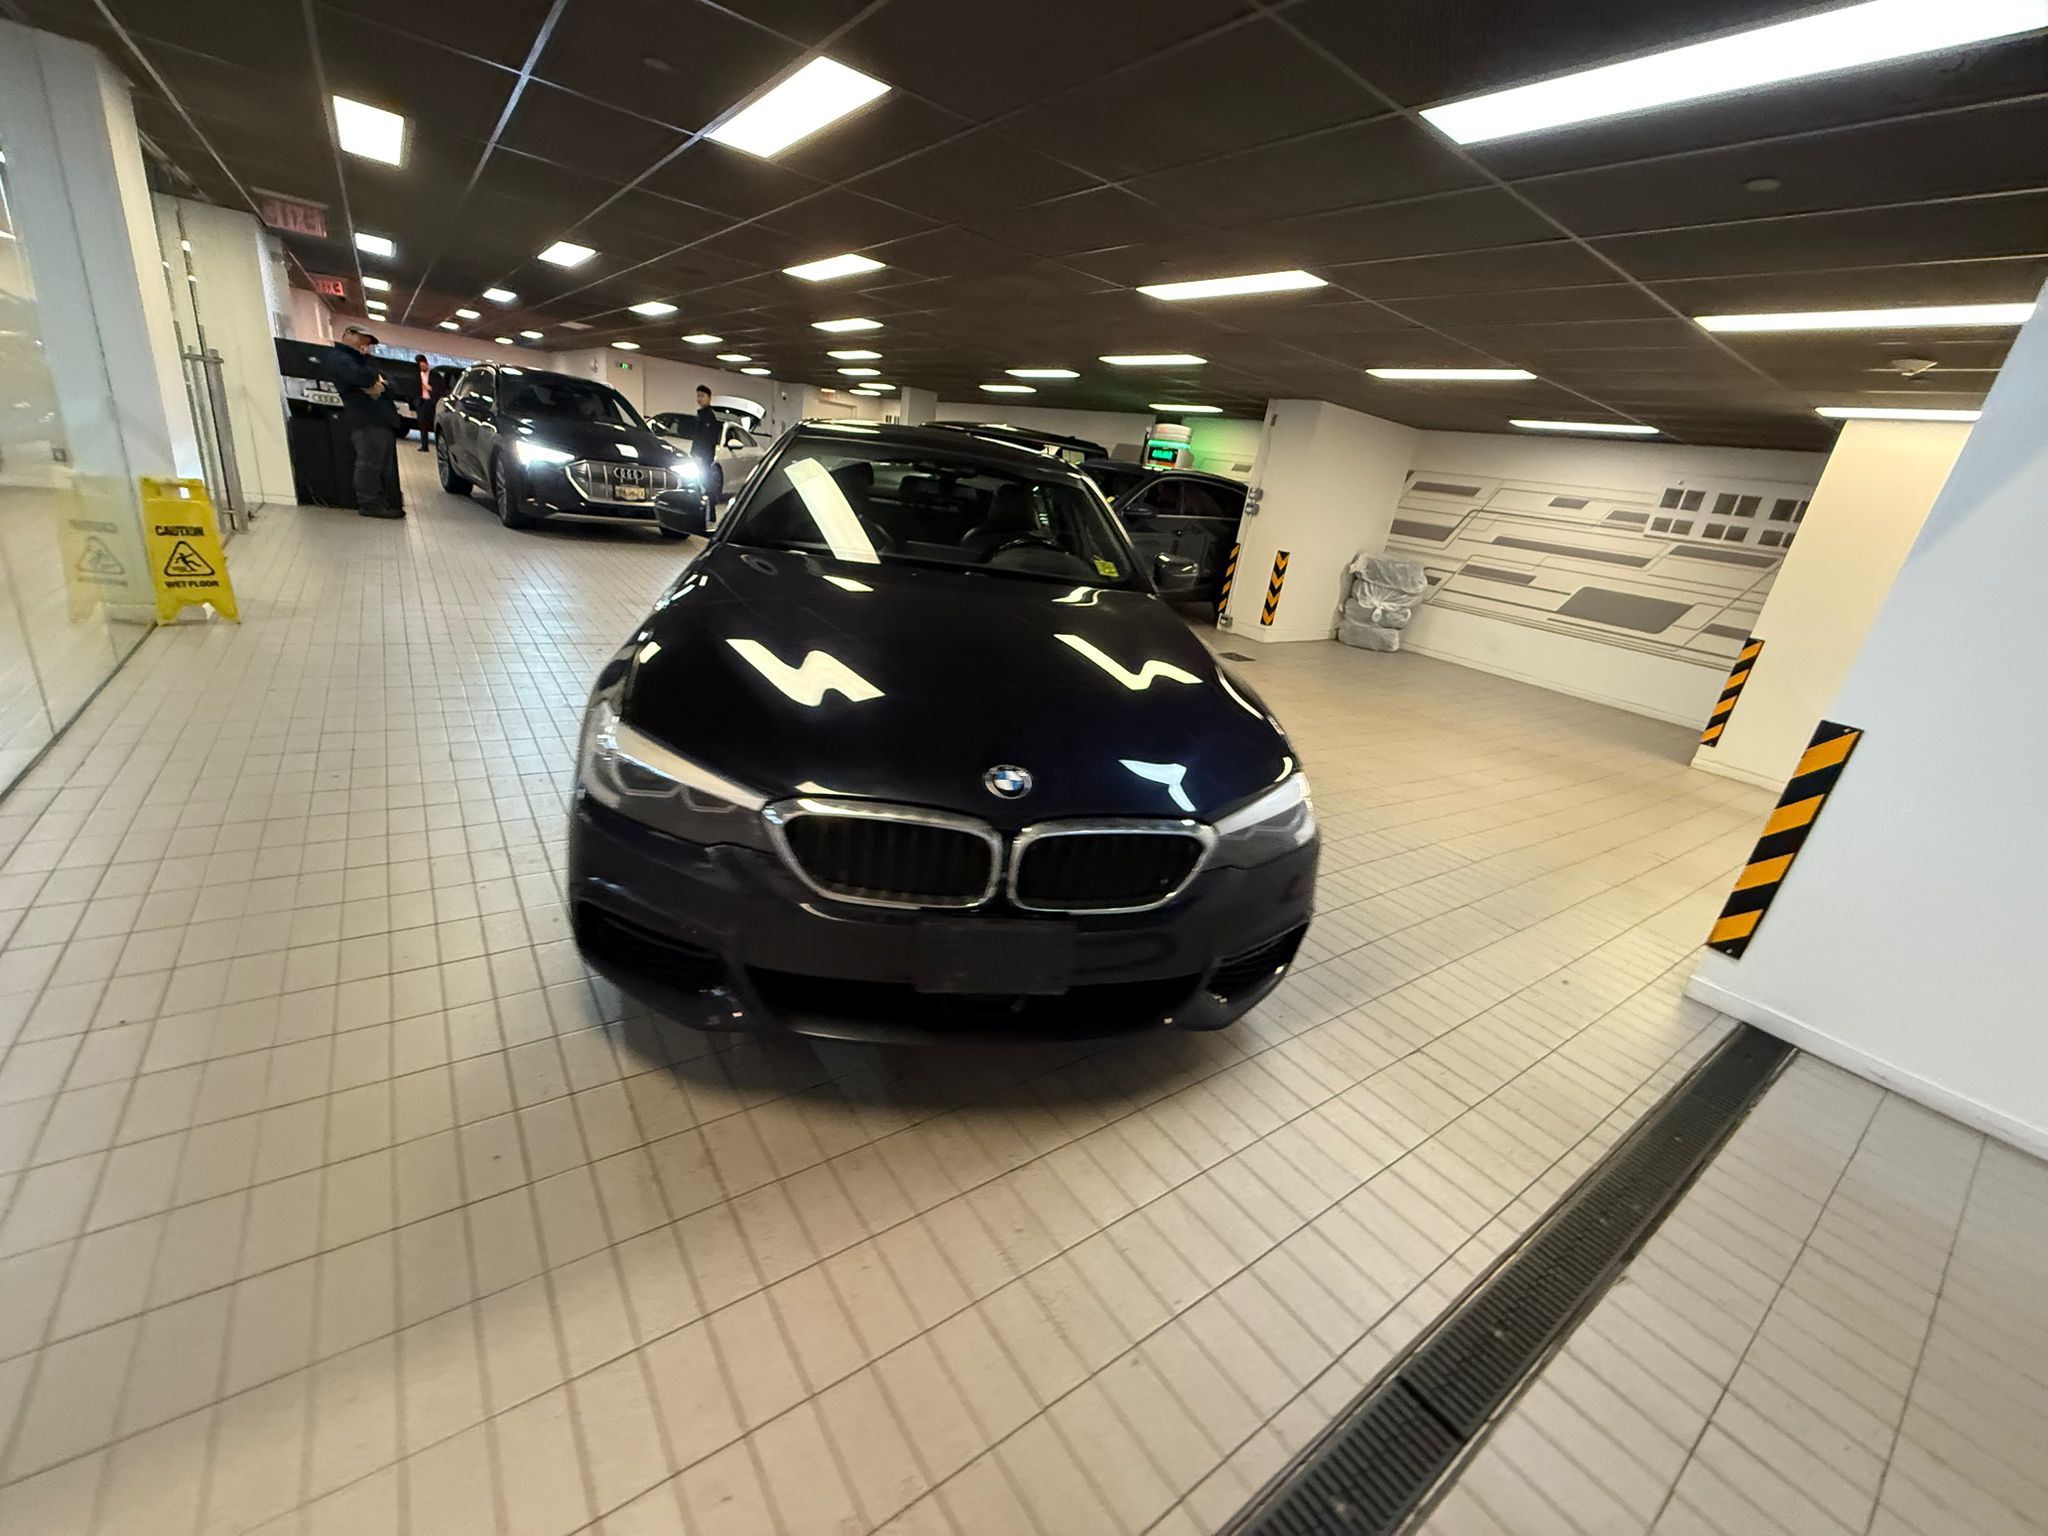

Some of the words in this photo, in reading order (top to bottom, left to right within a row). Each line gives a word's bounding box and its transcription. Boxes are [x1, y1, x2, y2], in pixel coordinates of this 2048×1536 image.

[155, 525, 204, 537] CAUTION
[164, 580, 187, 588] WET
[188, 580, 219, 588] FLOOR
